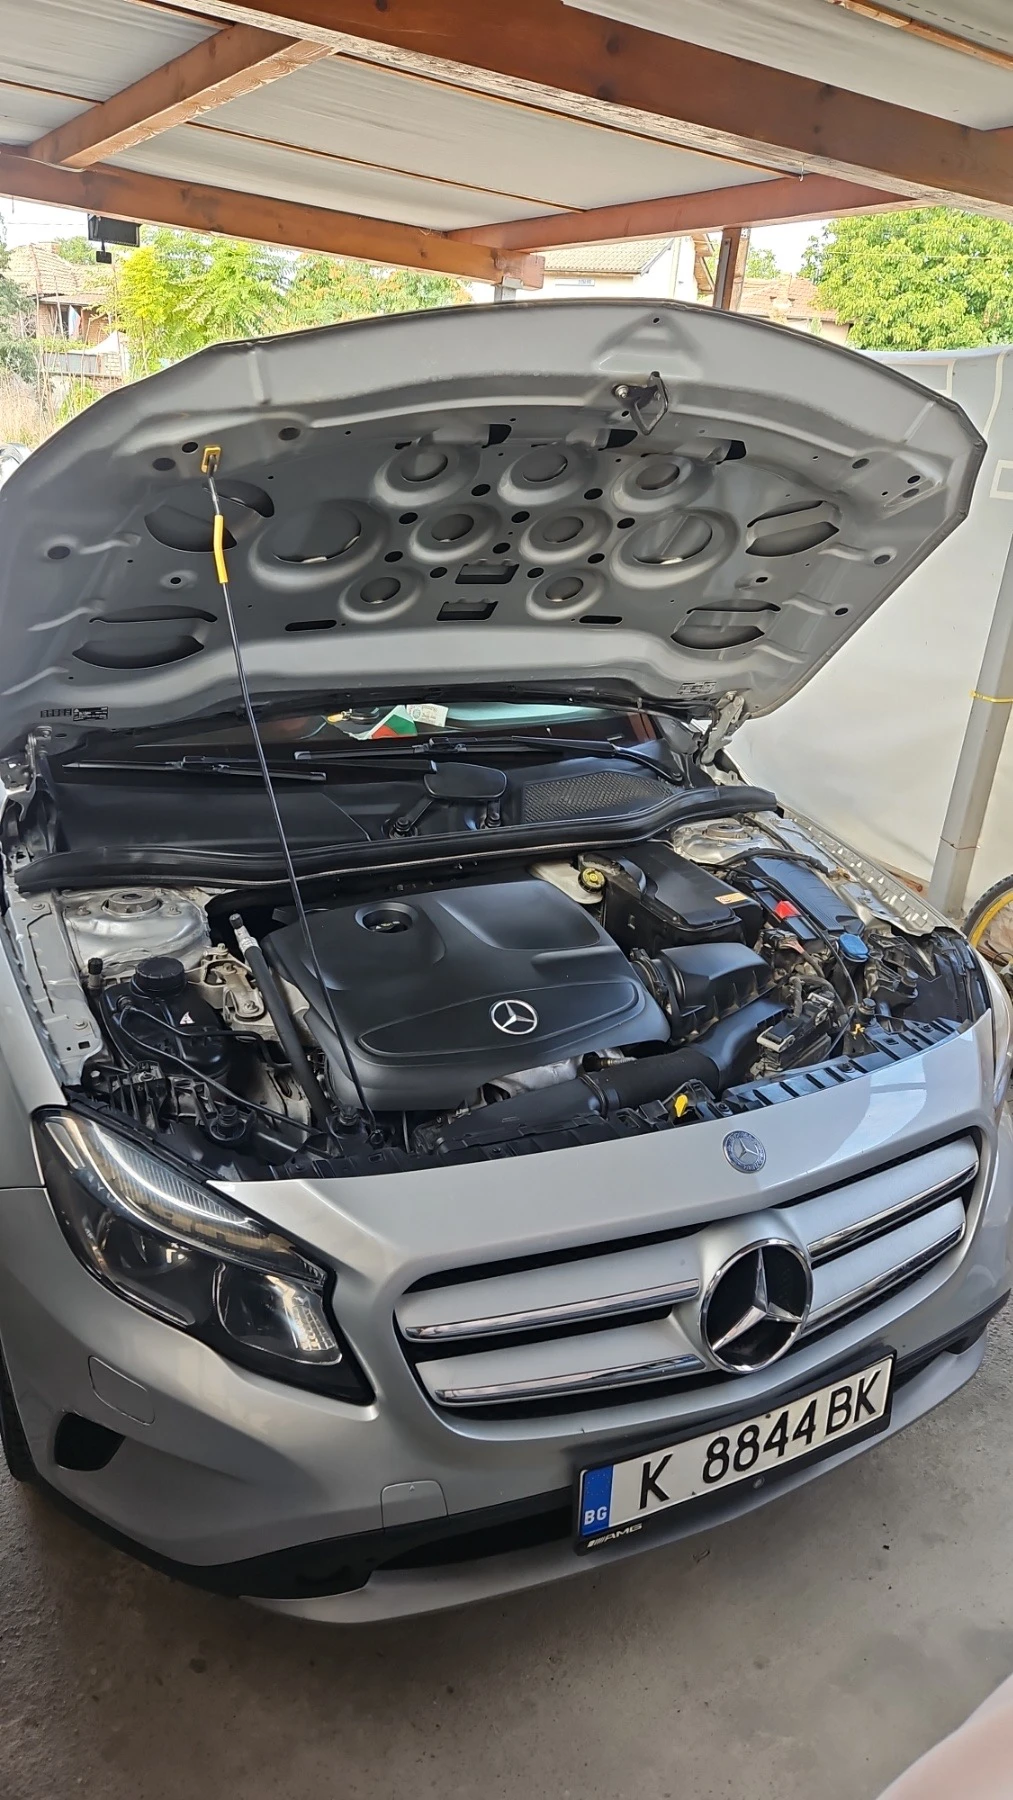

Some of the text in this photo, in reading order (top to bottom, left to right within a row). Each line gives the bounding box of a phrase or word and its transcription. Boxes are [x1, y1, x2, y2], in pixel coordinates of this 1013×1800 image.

[639, 1454, 673, 1510] K
[584, 1506, 608, 1526] BG
[603, 1523, 643, 1542] AMG
